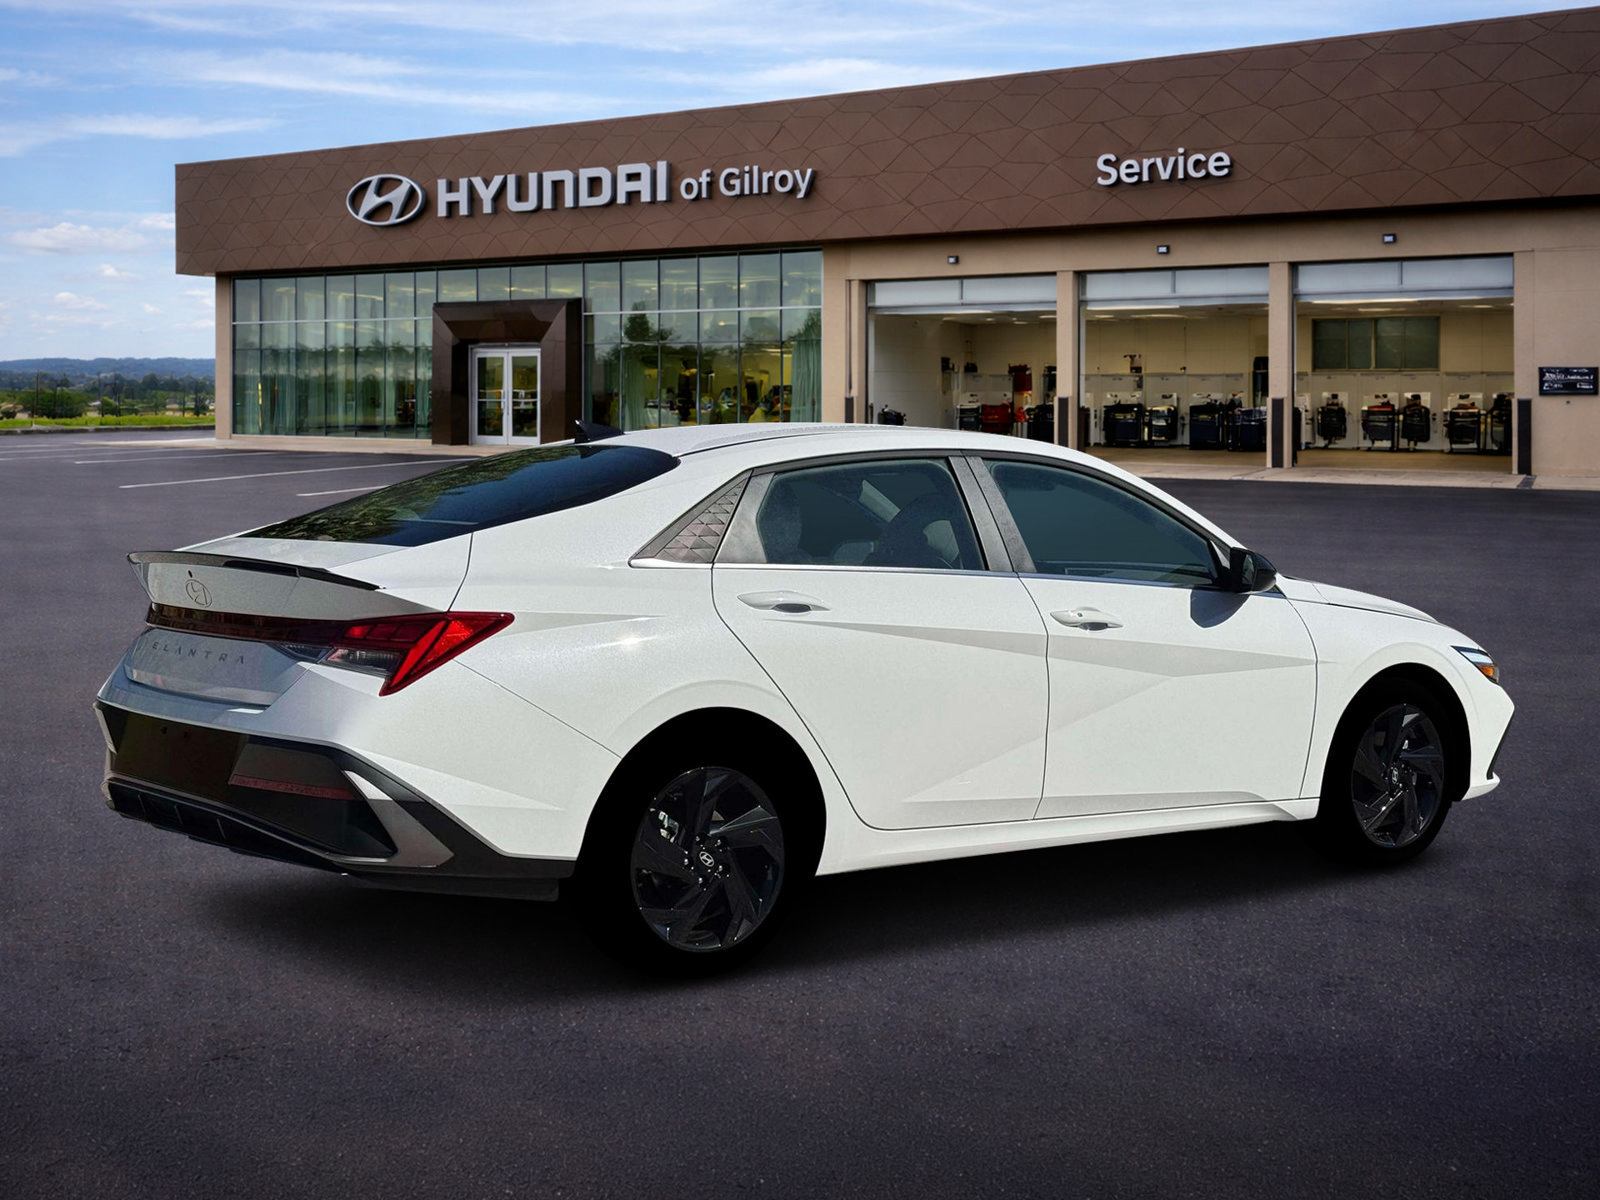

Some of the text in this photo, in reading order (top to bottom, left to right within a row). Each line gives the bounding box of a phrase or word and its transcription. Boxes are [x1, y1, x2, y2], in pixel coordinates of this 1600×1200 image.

[1096, 147, 1232, 186] Service
[437, 160, 813, 217] HYUNDAI of Gilroy
[152, 641, 244, 664] ELANTRA
